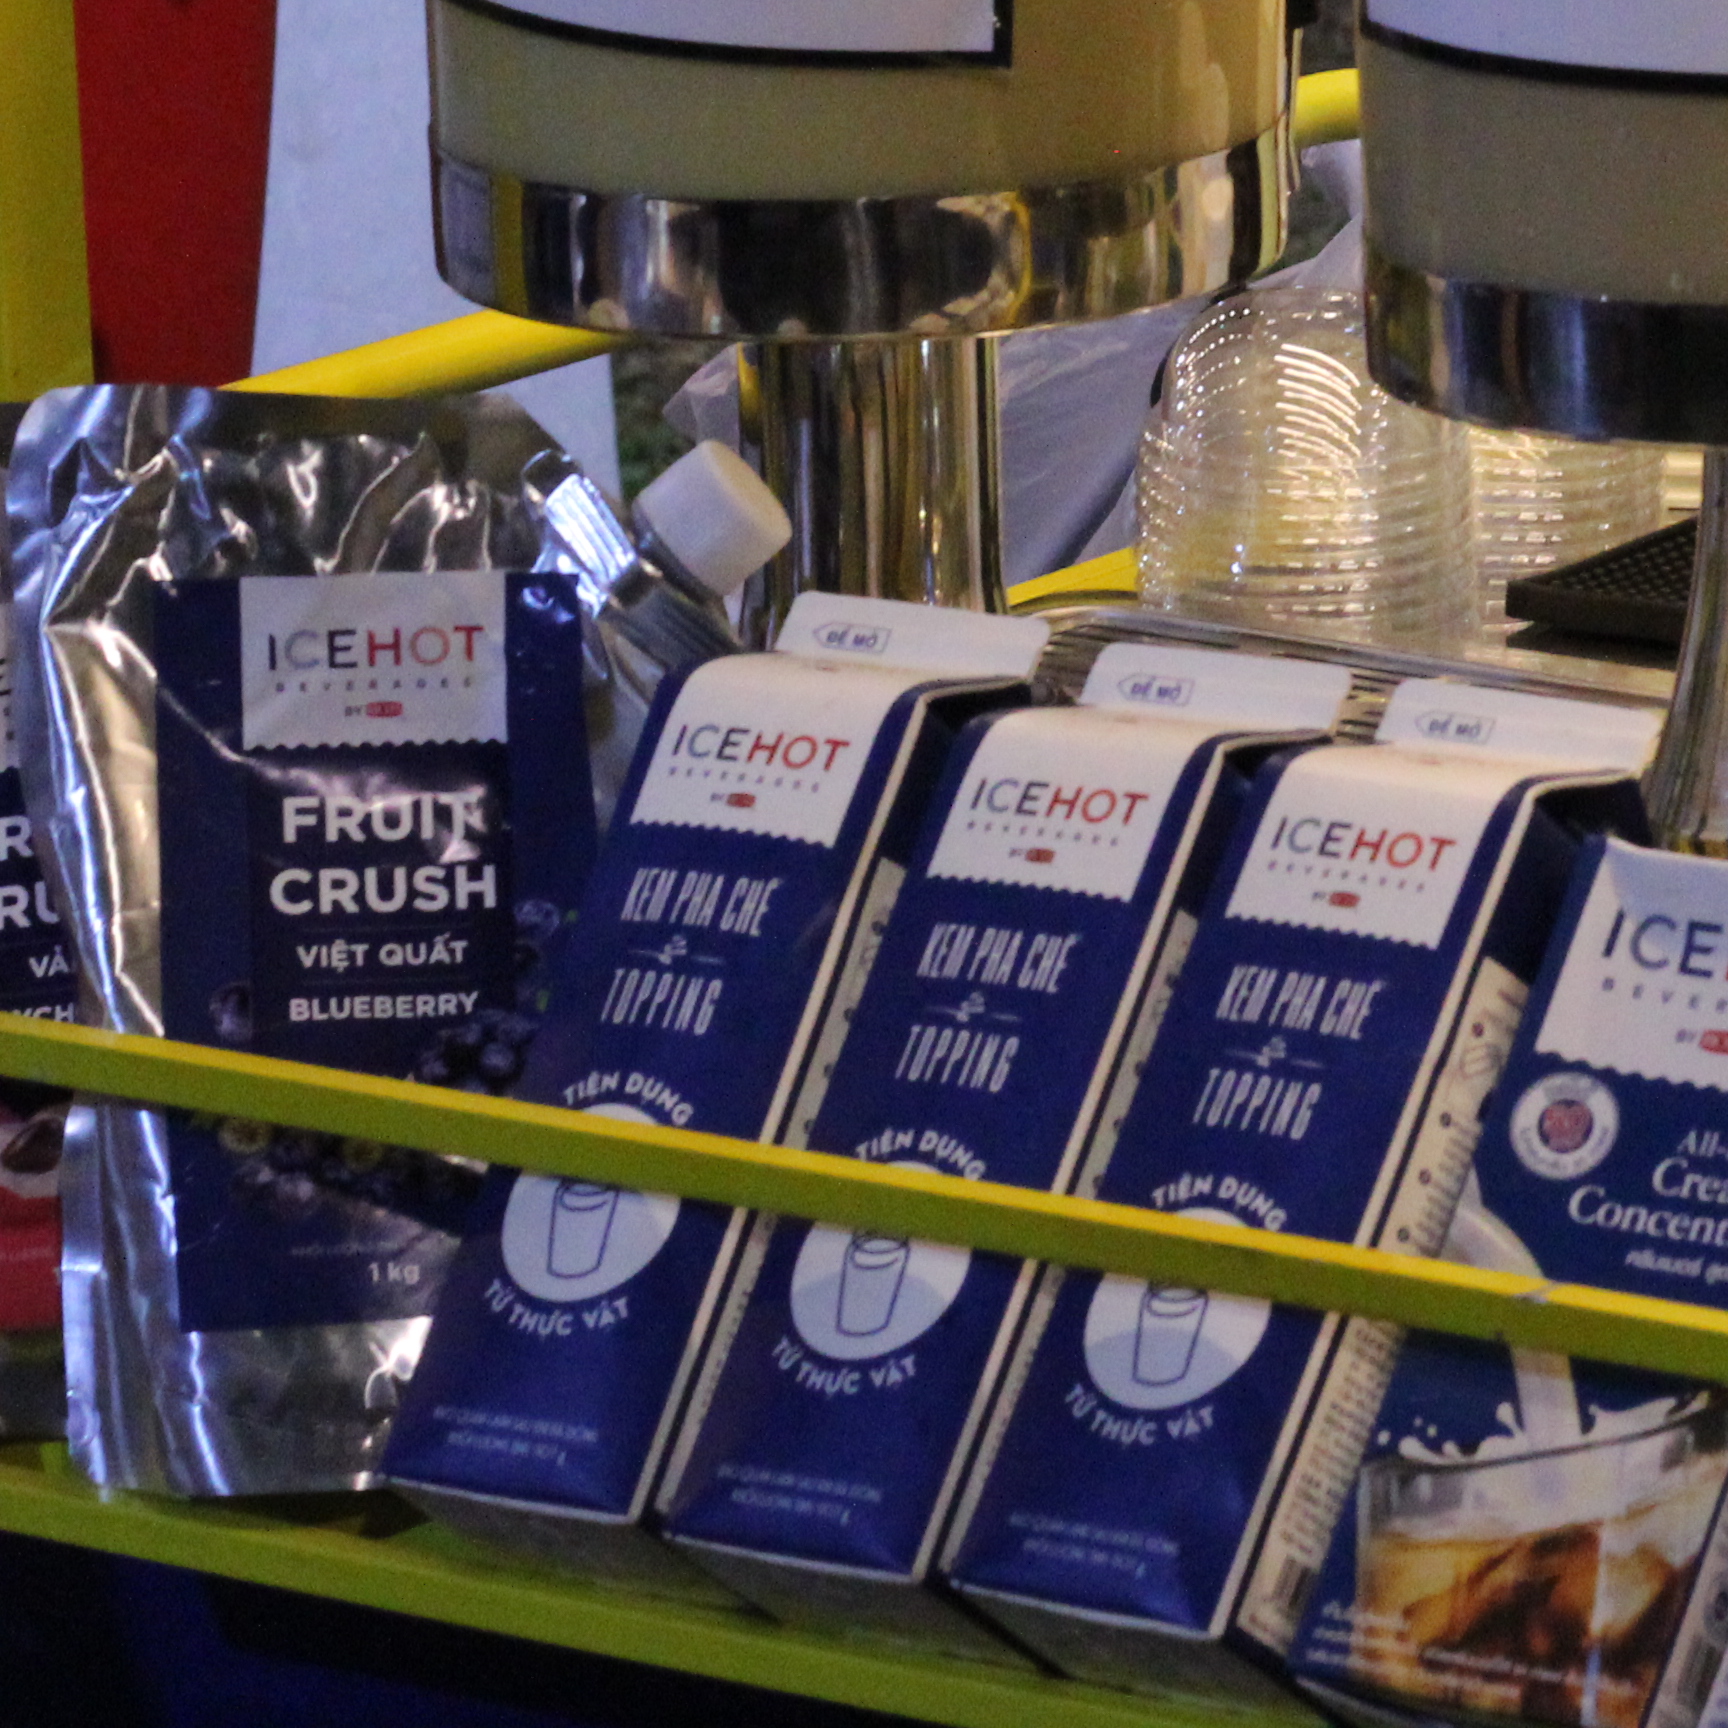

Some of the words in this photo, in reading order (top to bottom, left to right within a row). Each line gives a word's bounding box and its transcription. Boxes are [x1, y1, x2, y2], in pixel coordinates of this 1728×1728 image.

[267, 625, 484, 671] ICEHOT
[671, 723, 851, 772] ICEHOT
[281, 794, 484, 845] FRUIT
[968, 776, 1151, 827] ICEHOT
[1270, 816, 1458, 872] ICEHOT
[269, 866, 497, 915] CRUSH
[296, 935, 369, 973] VIỆT
[379, 929, 469, 968] QUẤT
[288, 990, 480, 1022] BLUEBERRY
[600, 968, 724, 1037] TOPPING
[894, 1023, 1021, 1094] TOPPING
[1192, 1067, 1323, 1142] TOPPING
